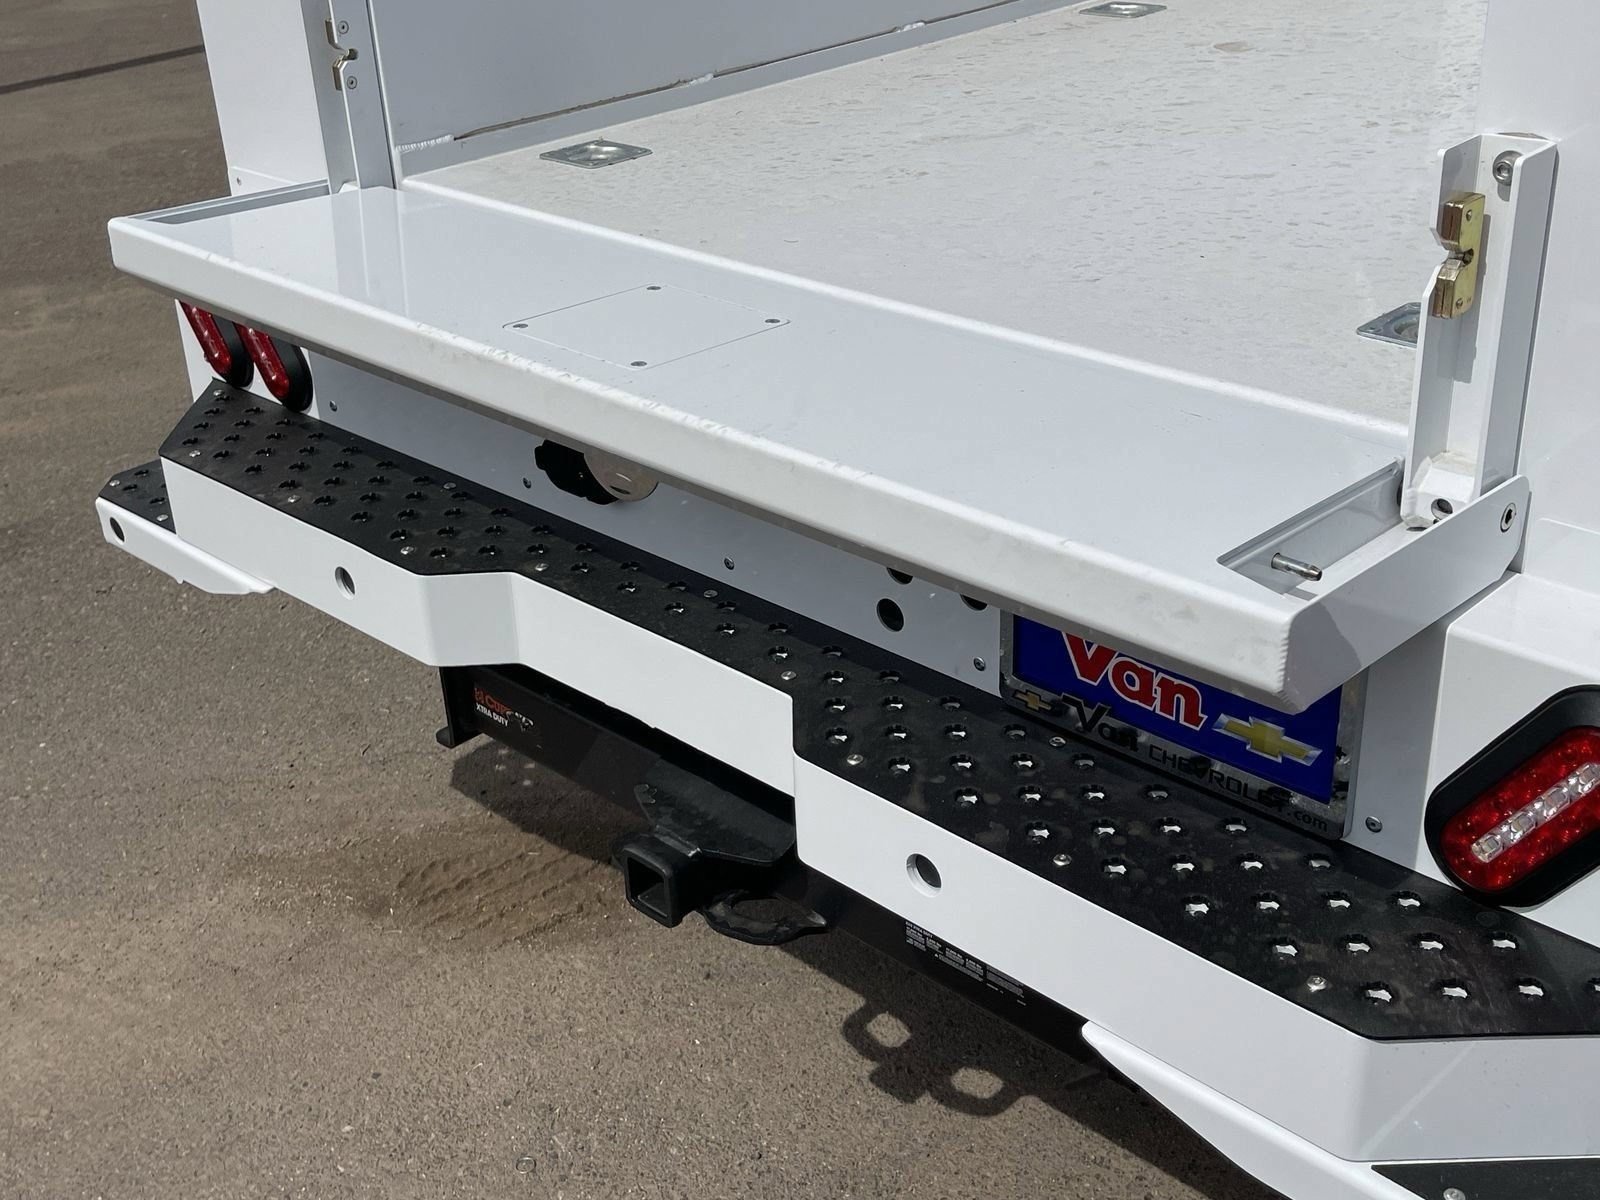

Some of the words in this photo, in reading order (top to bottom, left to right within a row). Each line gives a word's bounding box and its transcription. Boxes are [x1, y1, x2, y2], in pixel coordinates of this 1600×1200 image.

[1061, 630, 1208, 731] Van
[475, 702, 493, 719] XTRA
[492, 711, 509, 727] DUTY
